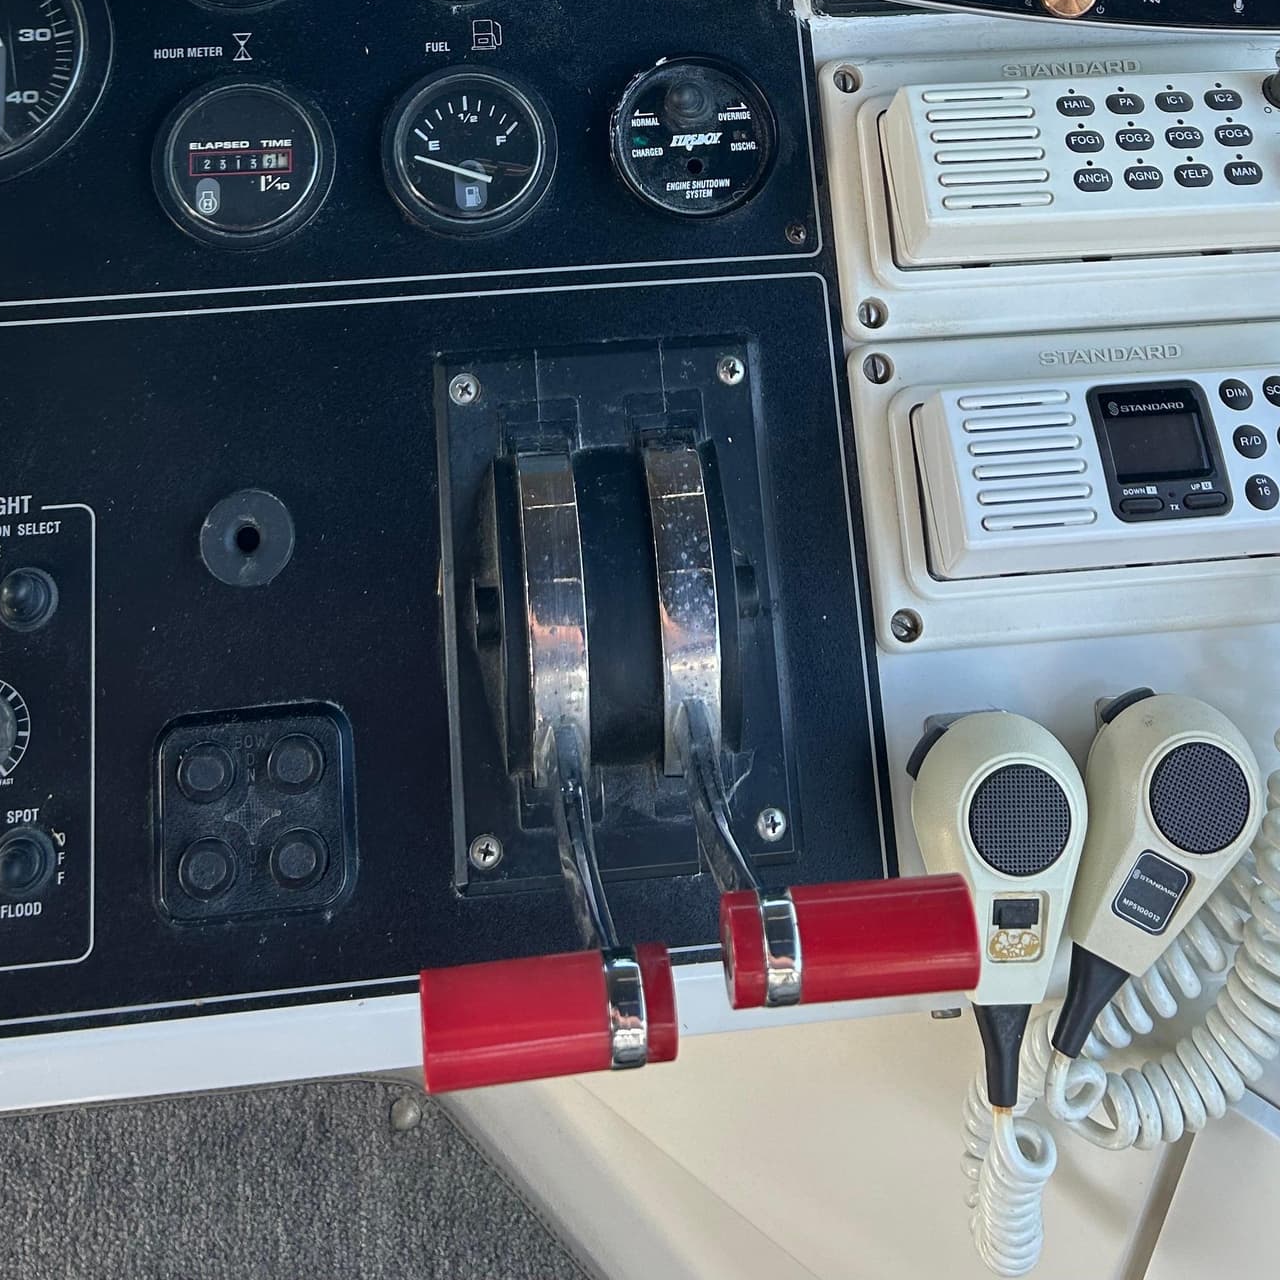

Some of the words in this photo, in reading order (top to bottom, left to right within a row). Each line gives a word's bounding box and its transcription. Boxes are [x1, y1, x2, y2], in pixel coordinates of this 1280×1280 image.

[18, 28, 52, 42] 30
[153, 48, 185, 59] HOUR
[187, 46, 223, 58] METER
[425, 41, 451, 53] FUEL
[1001, 59, 1141, 80] STANDARD
[5, 90, 40, 104] 40
[1063, 100, 1090, 109] HAIL
[1119, 97, 1134, 107] PA
[1166, 96, 1184, 104] IC1
[1214, 93, 1233, 103] IC2
[631, 117, 660, 127] NORMAL
[718, 111, 751, 121] OVERRIDE
[496, 135, 507, 146] F
[1070, 135, 1100, 145] FOG1
[1119, 133, 1151, 143] FOG2
[1168, 130, 1201, 141] FOG3
[1218, 129, 1250, 139] FOG4
[189, 140, 250, 150] ELAPSED
[260, 139, 292, 148] TIME
[428, 140, 440, 151] E
[730, 141, 758, 151] DISCHG.
[631, 147, 664, 158] CHARGED
[1078, 173, 1110, 184] ANCH
[1128, 171, 1160, 182] AGND
[1179, 169, 1209, 179] YELP
[1231, 167, 1257, 177] MAN
[666, 180, 691, 191] ENGINE
[692, 178, 731, 190] SHUTDOWN
[685, 188, 713, 199] SYSTEM
[1039, 343, 1183, 367] STANDARD
[1225, 387, 1248, 398] DIM
[1120, 401, 1185, 413] STANDARD
[1240, 437, 1262, 447] R/D
[1123, 487, 1146, 496] DOWN
[1190, 483, 1200, 491] UP
[1258, 486, 1270, 496] 16
[17, 521, 61, 536] SELECT
[6, 808, 40, 824] SPOT
[1140, 874, 1178, 898] STANDARD
[0, 901, 42, 919] FLOOD
